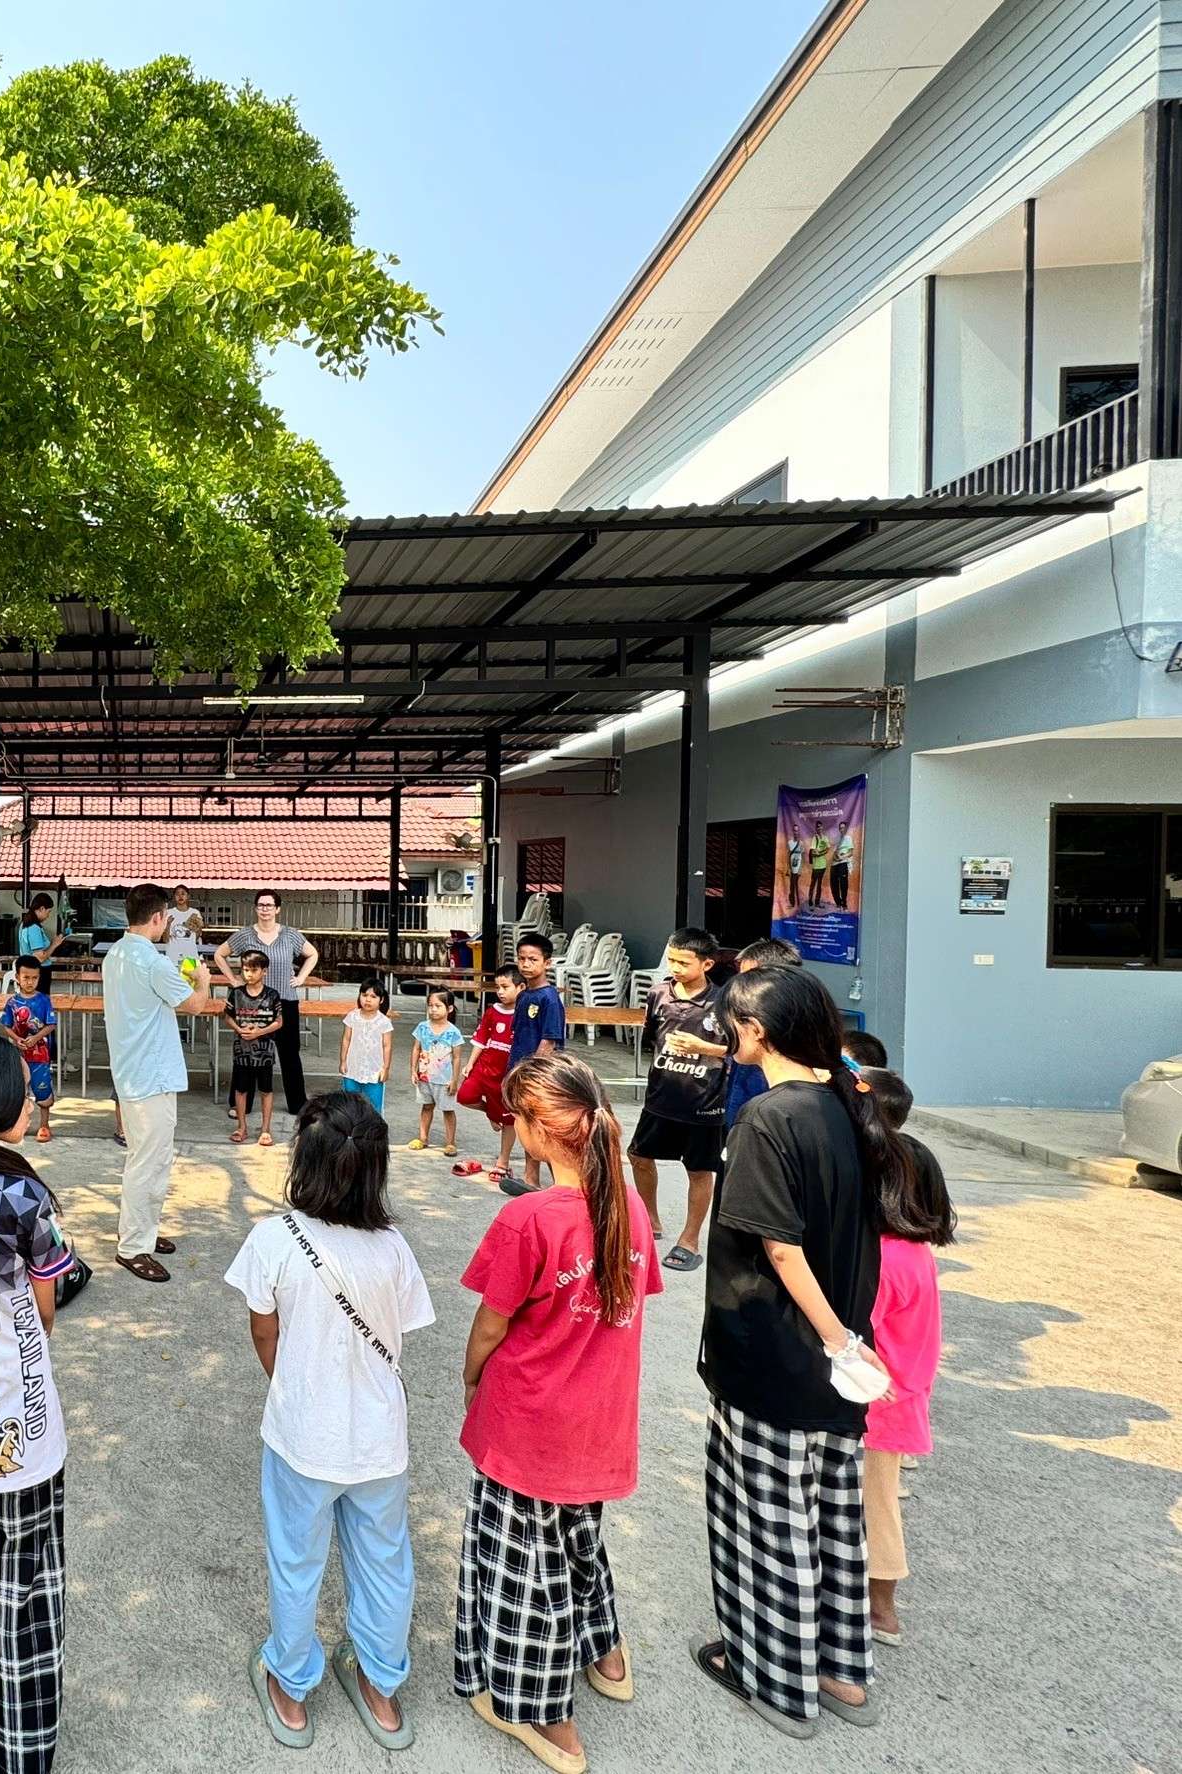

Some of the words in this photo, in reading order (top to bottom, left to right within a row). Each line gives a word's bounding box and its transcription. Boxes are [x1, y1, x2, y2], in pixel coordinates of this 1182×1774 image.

[654, 1055, 708, 1079] Chang
[296, 1234, 323, 1269] FLASH
[334, 1291, 355, 1316] BEAR
[350, 1315, 373, 1339] FLASH
[11, 1283, 48, 1441] THAILAND
